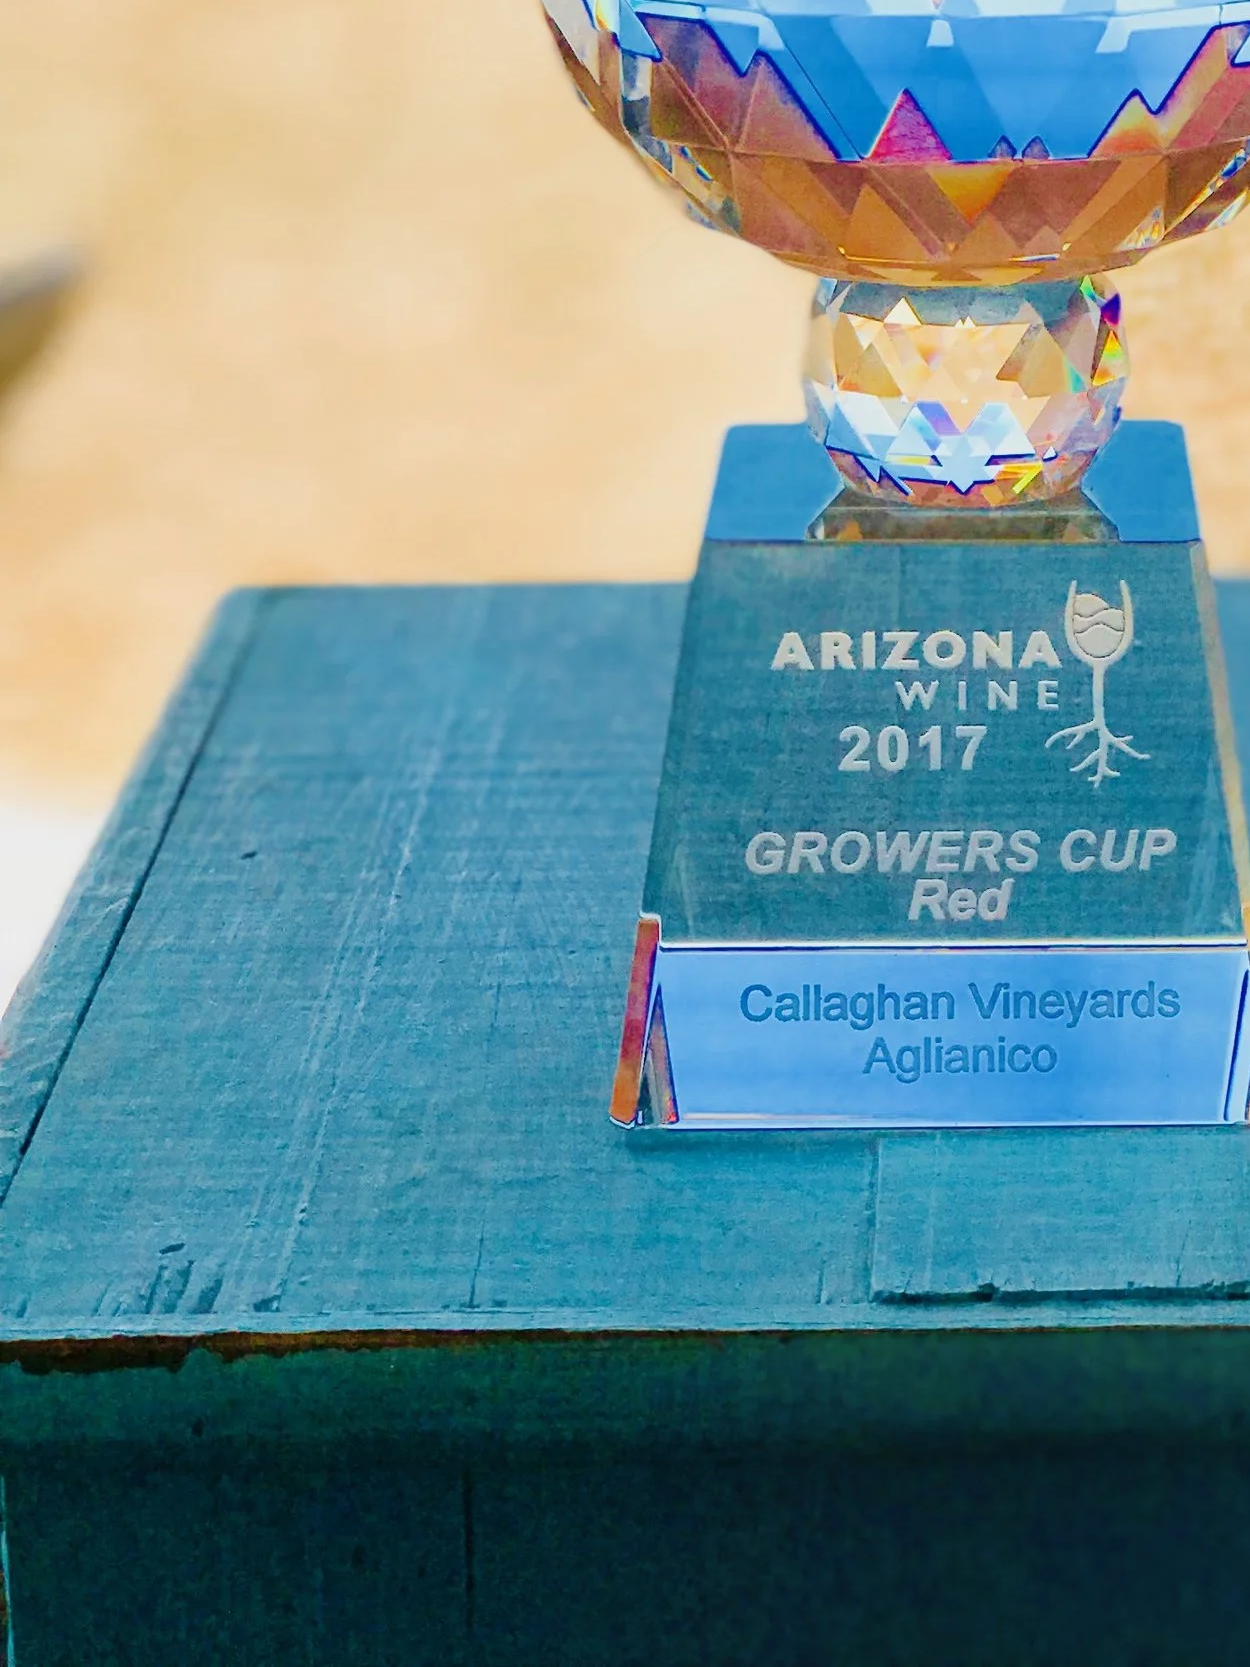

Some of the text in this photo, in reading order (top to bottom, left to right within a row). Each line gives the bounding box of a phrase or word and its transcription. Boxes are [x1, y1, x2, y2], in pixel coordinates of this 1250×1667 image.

[771, 631, 1062, 671] ARIZONA
[895, 679, 1059, 711] WINE
[839, 725, 988, 771] 2017
[745, 829, 1177, 874] GROWERS CUP
[908, 878, 1016, 922] Red
[739, 981, 1181, 1031] Callaghan Vineyards
[862, 1037, 1057, 1083] Aglianico
